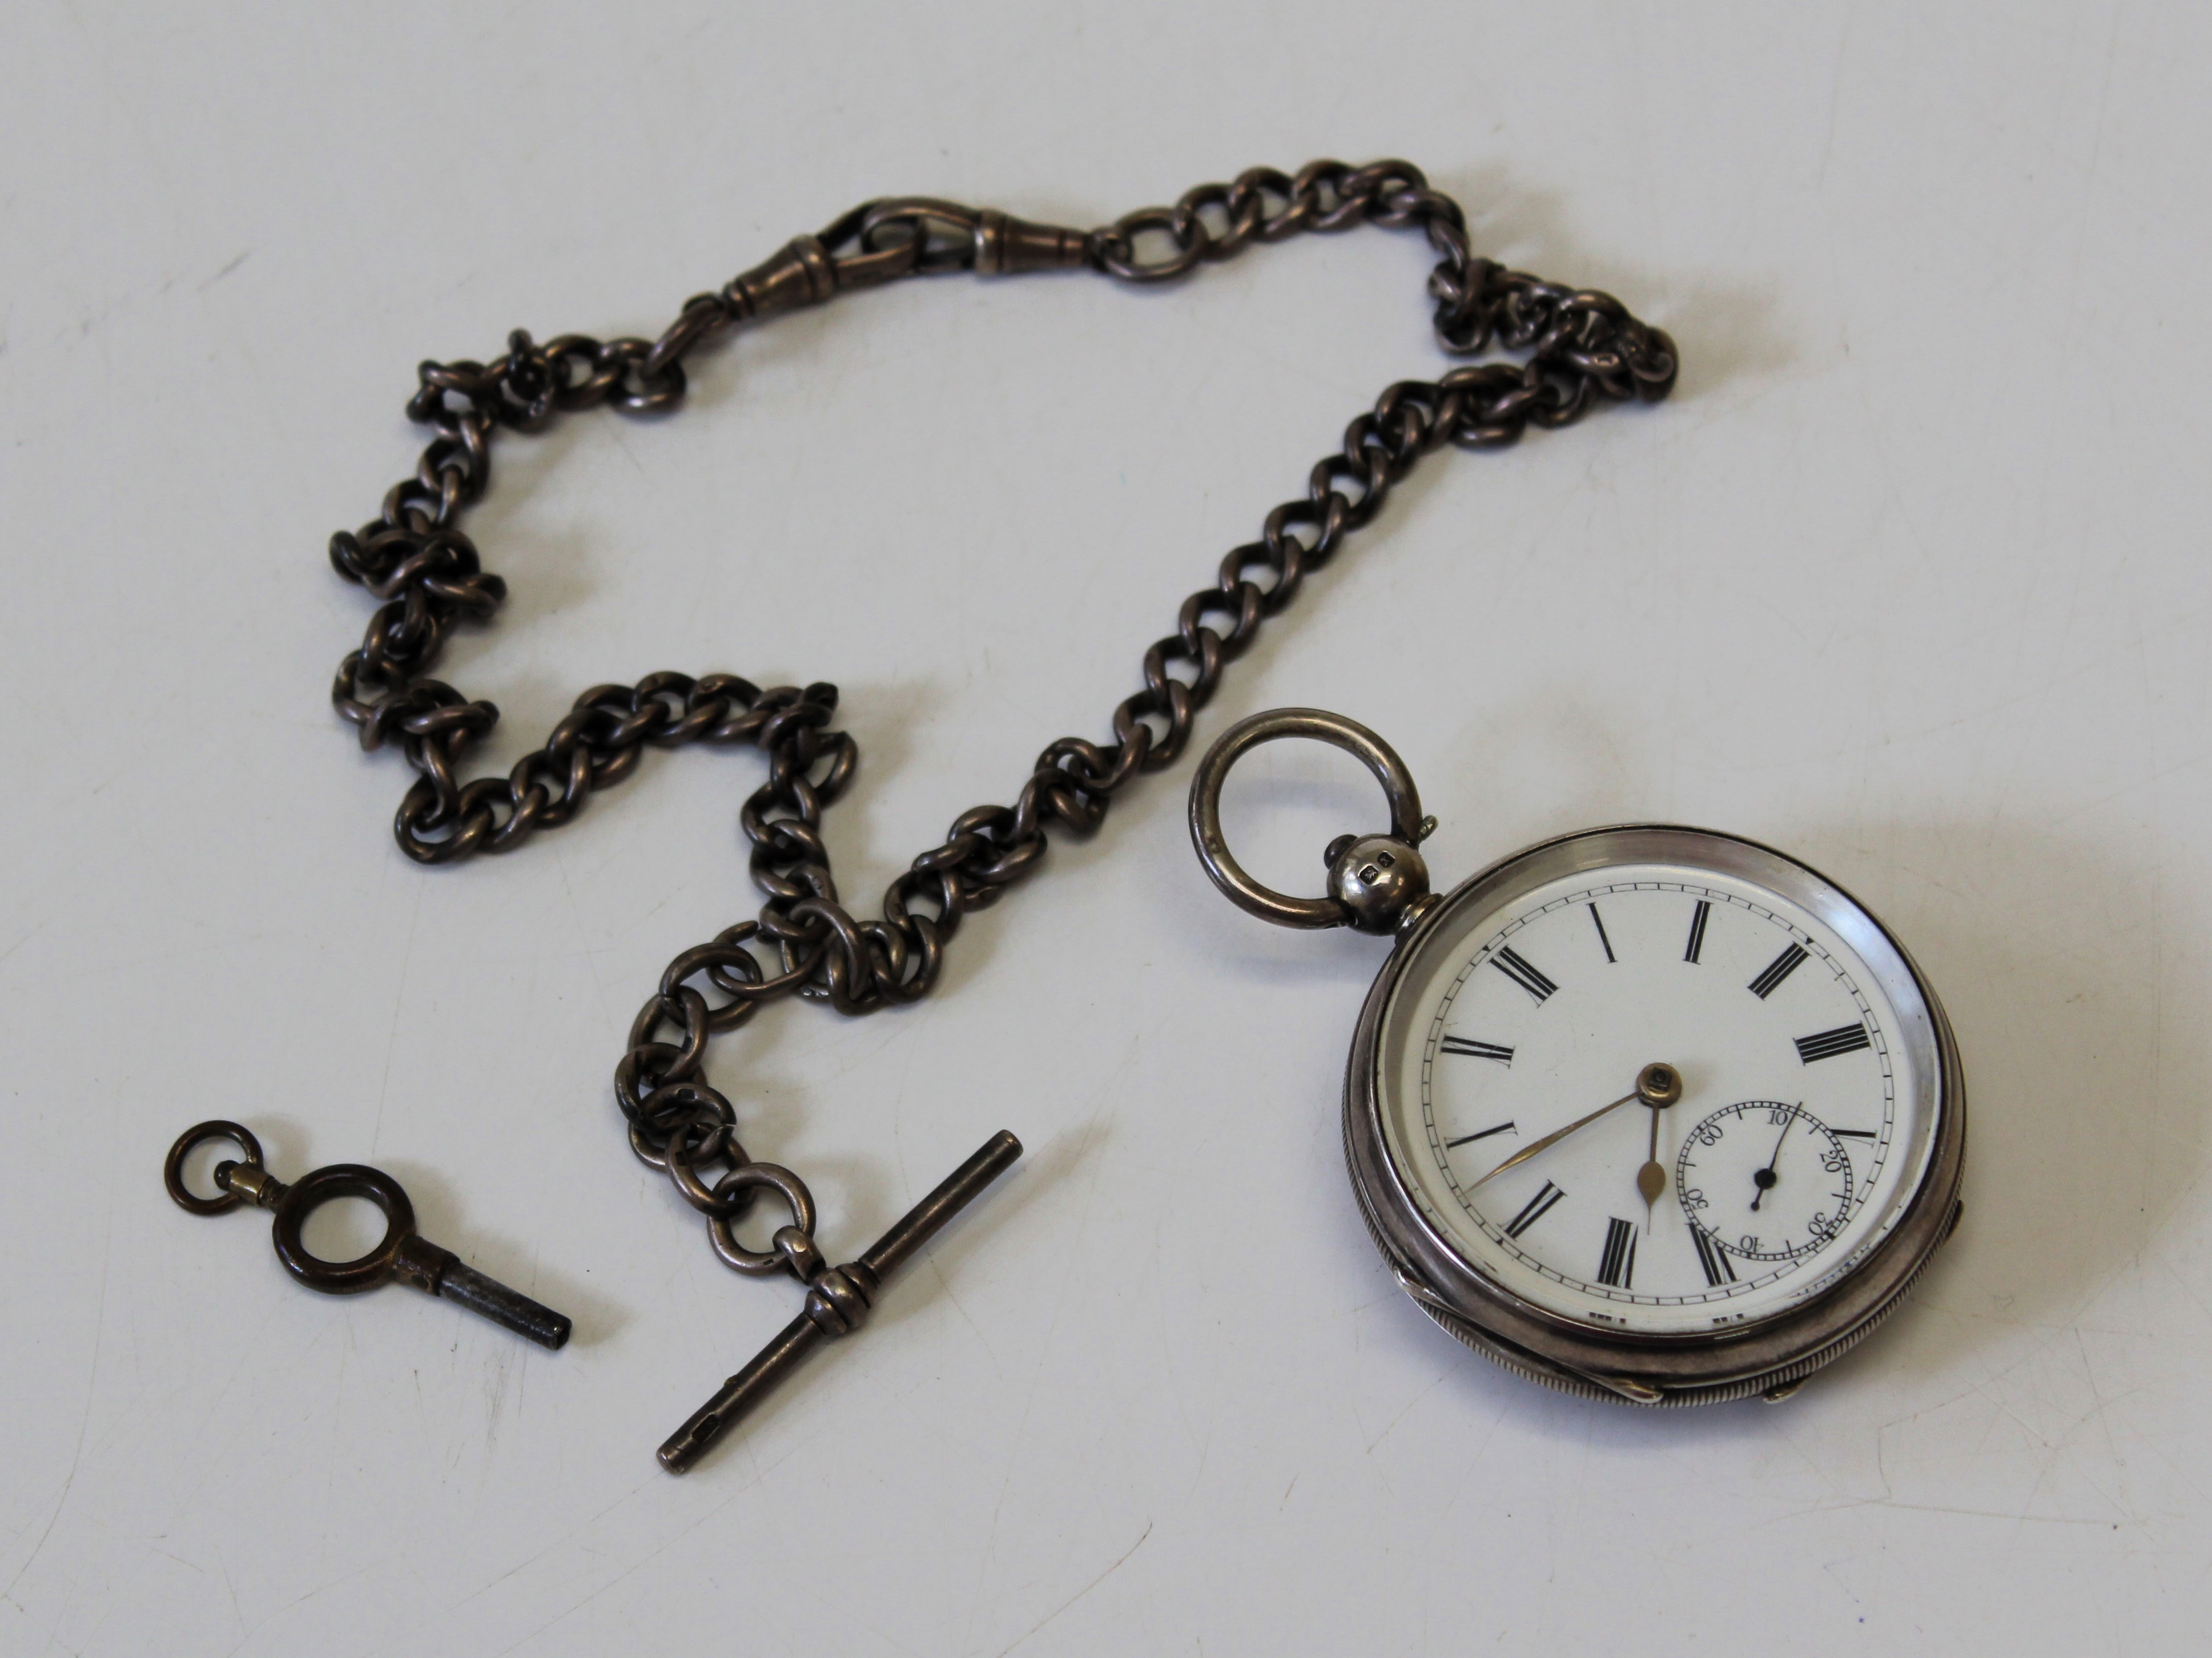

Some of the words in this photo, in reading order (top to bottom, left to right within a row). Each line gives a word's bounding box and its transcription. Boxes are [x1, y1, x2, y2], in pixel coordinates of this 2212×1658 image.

[1586, 902, 1618, 964] I
[1682, 899, 1714, 965] II
[1486, 943, 1561, 1009] XII
[1747, 940, 1812, 1001] III
[1439, 1033, 1516, 1069] XI
[1792, 1020, 1873, 1067] IIII
[1443, 1119, 1518, 1152] X
[1699, 1124, 1723, 1146] 60
[1767, 1109, 1788, 1126] 10
[1819, 1149, 1843, 1173] 20
[1496, 1178, 1568, 1242] IX
[1686, 1188, 1710, 1211] 50
[1807, 1212, 1833, 1236] 30
[1594, 1216, 1639, 1290] VIII
[1739, 1234, 1765, 1253] 40
